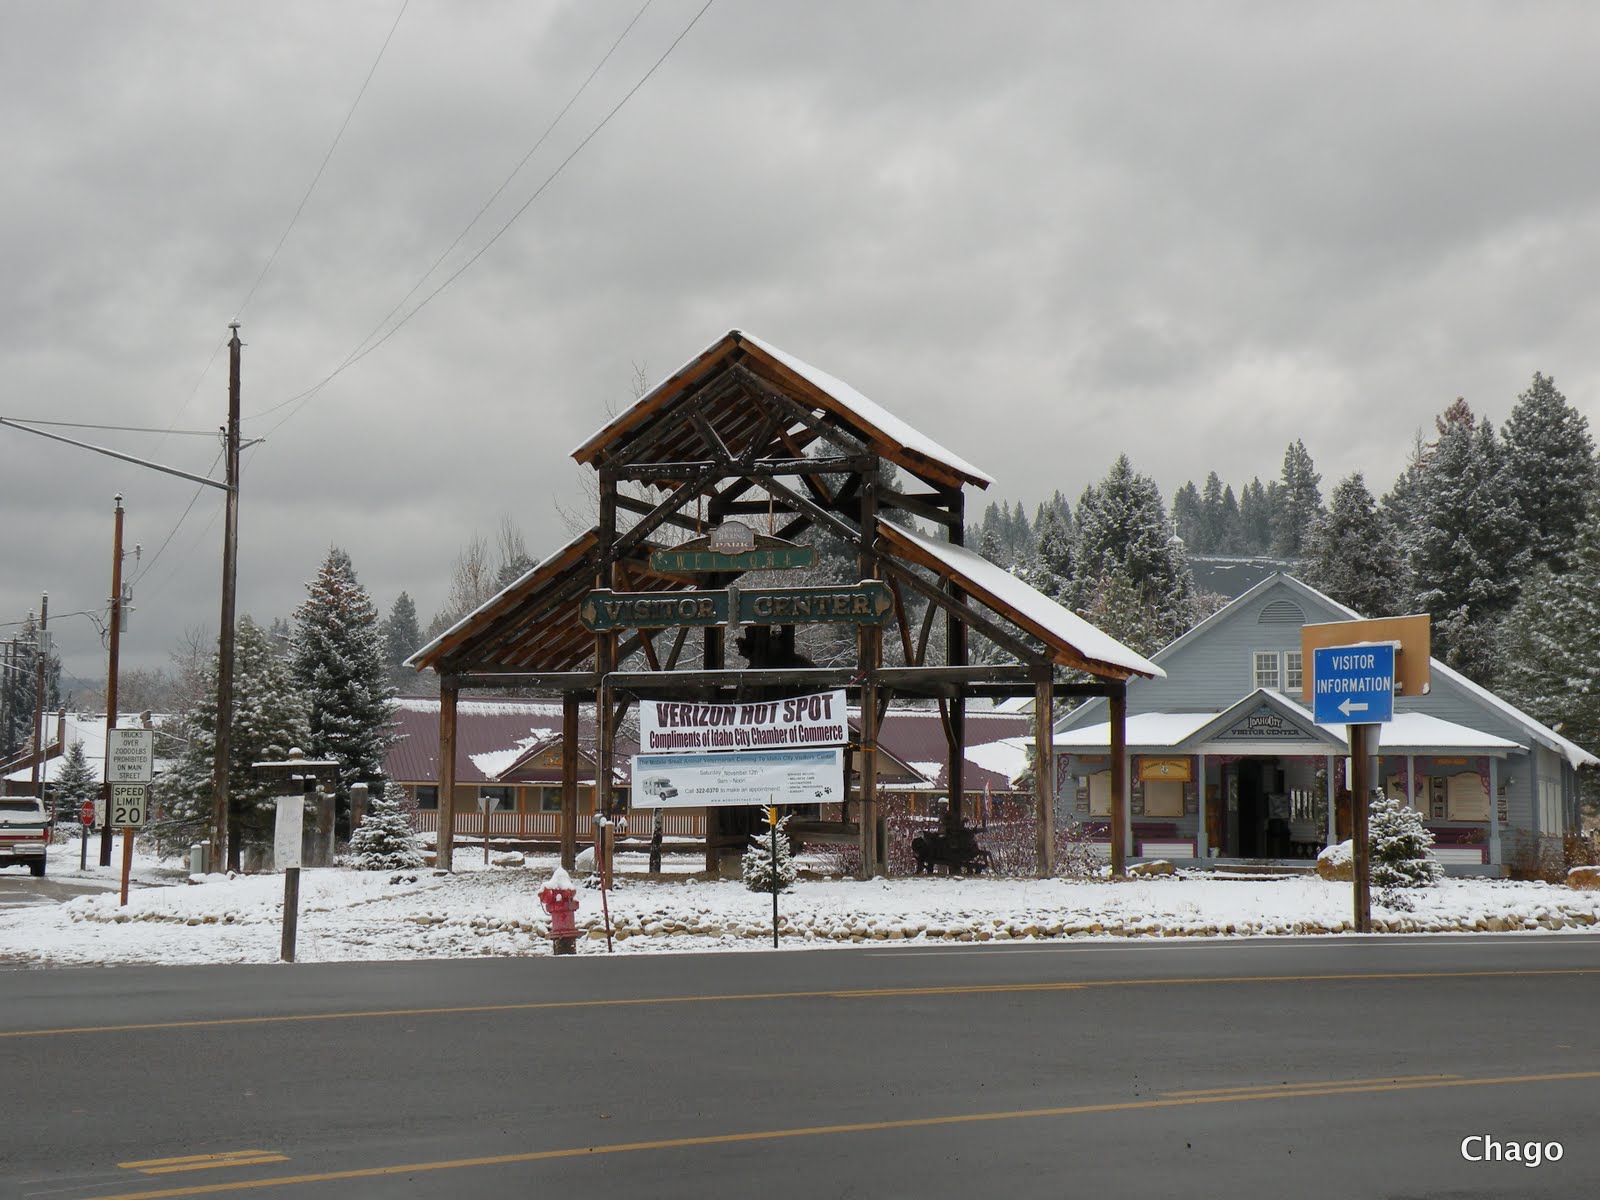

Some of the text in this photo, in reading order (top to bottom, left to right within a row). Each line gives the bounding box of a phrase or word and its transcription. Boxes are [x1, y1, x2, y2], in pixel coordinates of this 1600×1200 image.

[603, 594, 872, 621] VISITOR CENTER
[1332, 654, 1375, 671] VISITOR
[1317, 676, 1391, 694] INFORMATION
[656, 703, 737, 728] VERIZON
[783, 694, 833, 723] SPOT
[649, 724, 843, 750] Compliments of Idaho City Chamber of Commerce
[115, 788, 144, 796] SPEED
[117, 798, 140, 806] LIMIT
[82, 809, 94, 817] STOP
[115, 807, 140, 823] 20
